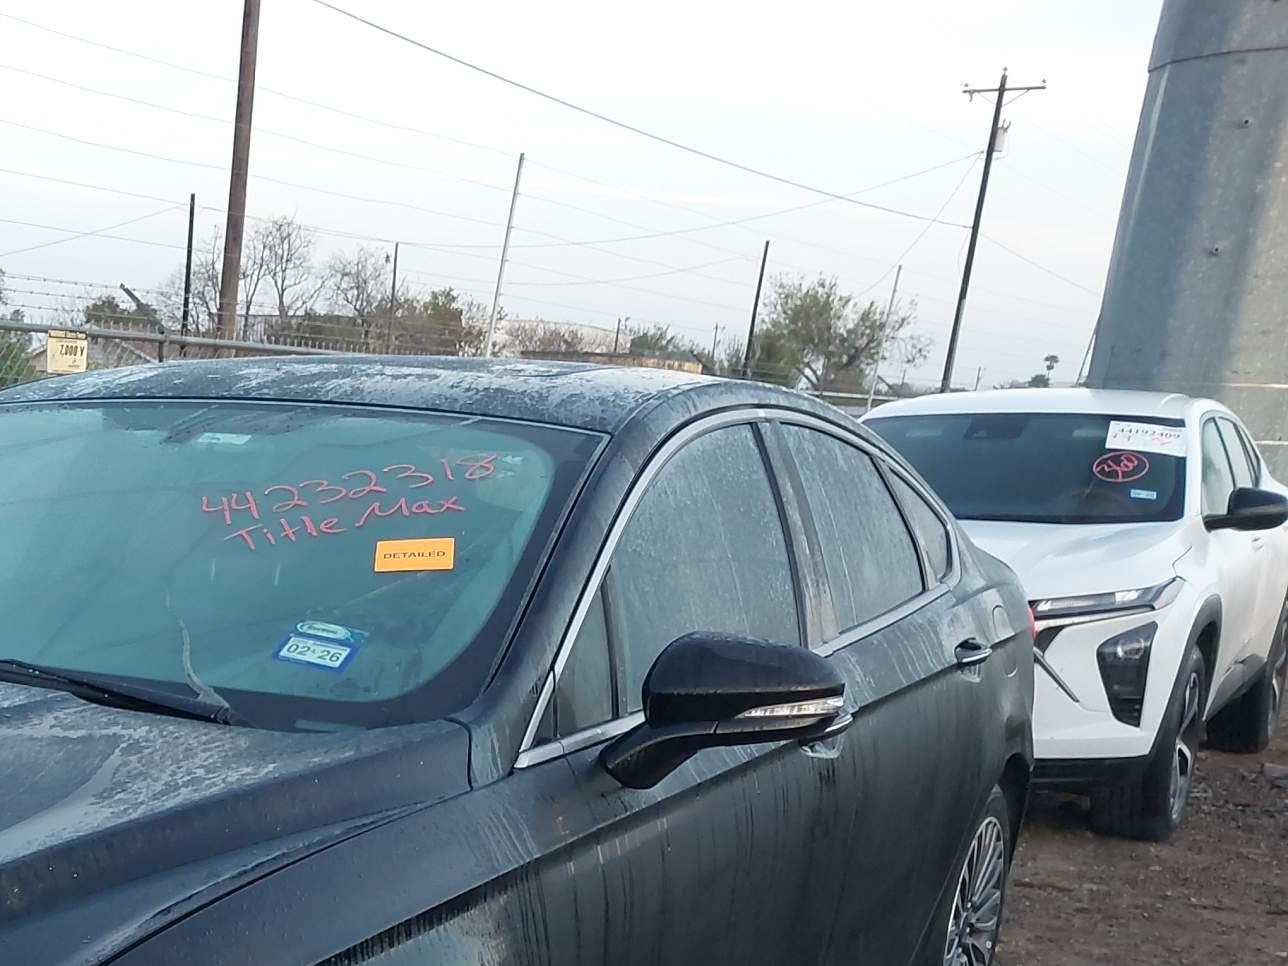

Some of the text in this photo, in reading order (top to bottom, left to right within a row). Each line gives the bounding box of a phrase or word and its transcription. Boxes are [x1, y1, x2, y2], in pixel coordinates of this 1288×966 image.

[201, 452, 497, 525] 44232318
[223, 495, 465, 550] Title Max
[383, 550, 446, 560] DETAILED
